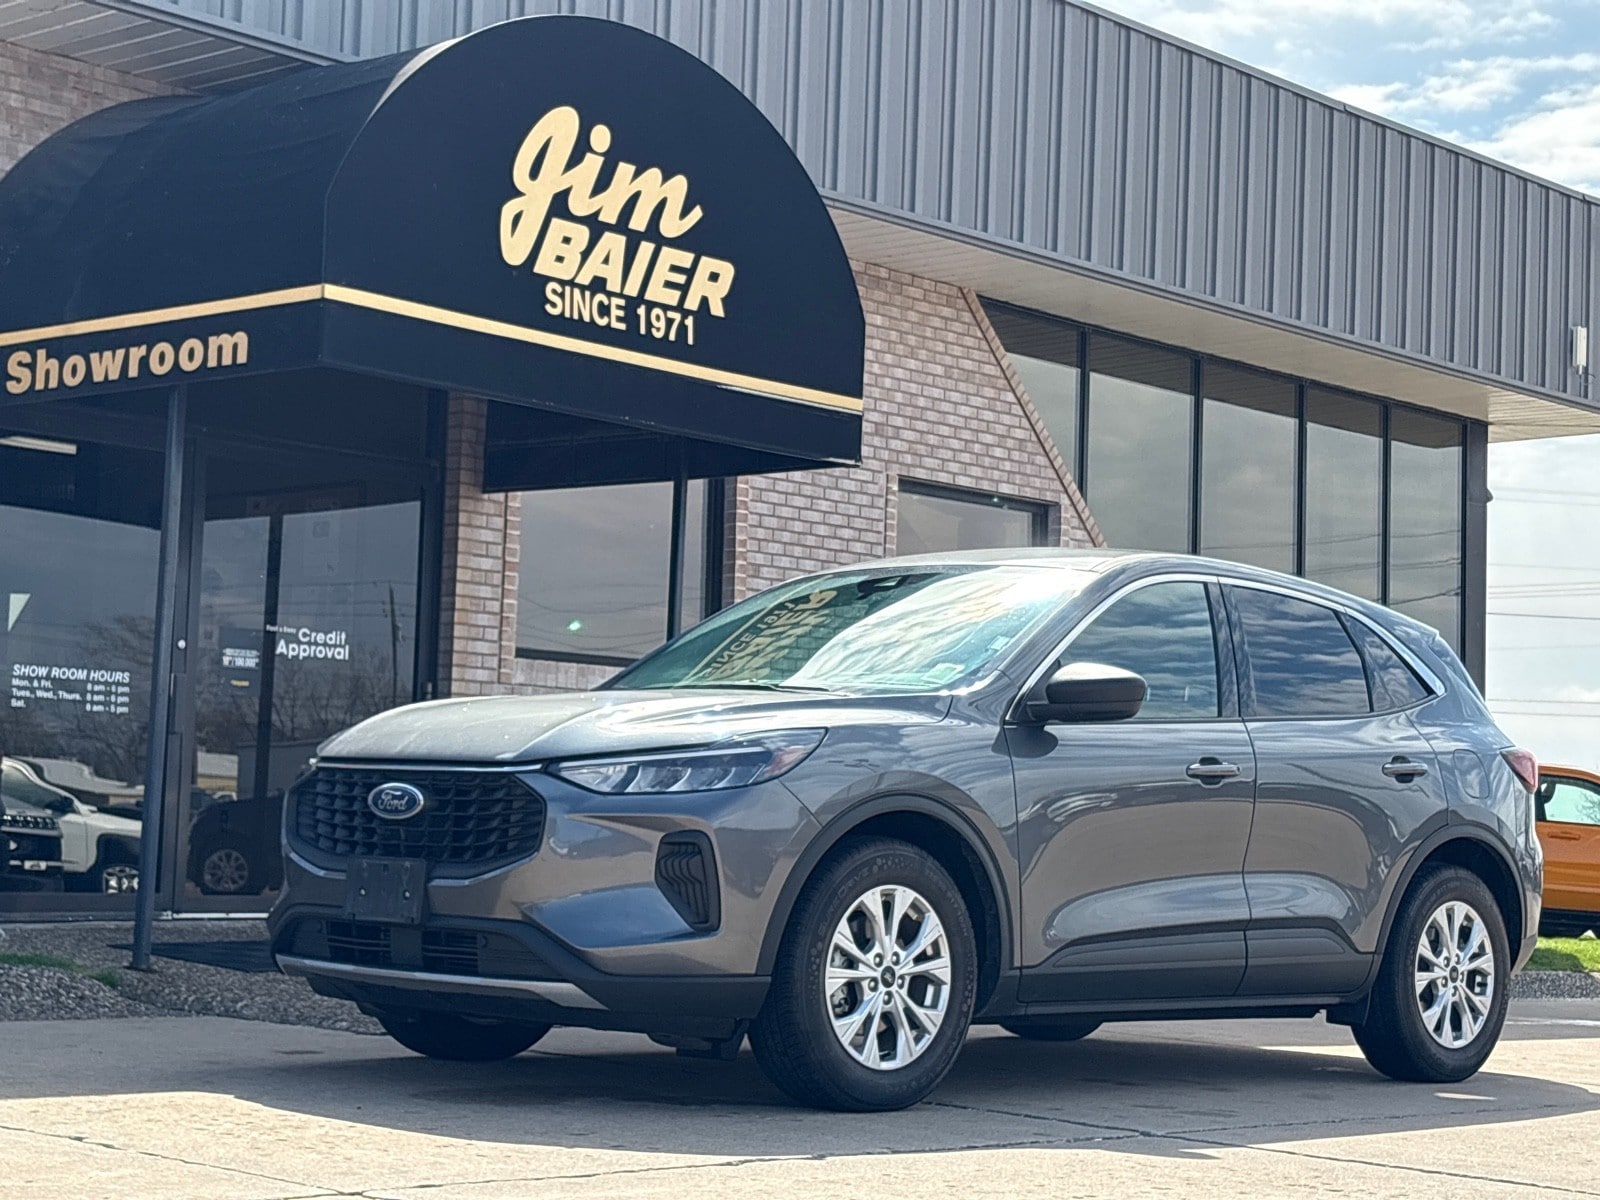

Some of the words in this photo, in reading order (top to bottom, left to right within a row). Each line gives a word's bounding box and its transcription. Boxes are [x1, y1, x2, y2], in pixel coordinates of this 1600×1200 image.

[500, 106, 703, 266] Jim
[533, 217, 735, 318] BAIER
[544, 282, 626, 331] SINCE
[637, 304, 694, 345] 1971
[6, 331, 248, 394] Showroom
[275, 639, 349, 660] Approval
[298, 628, 346, 645] Credit
[13, 664, 48, 678] SHOW
[51, 667, 87, 680] ROOM
[90, 670, 130, 683] HOURS
[378, 790, 408, 810] Ford
